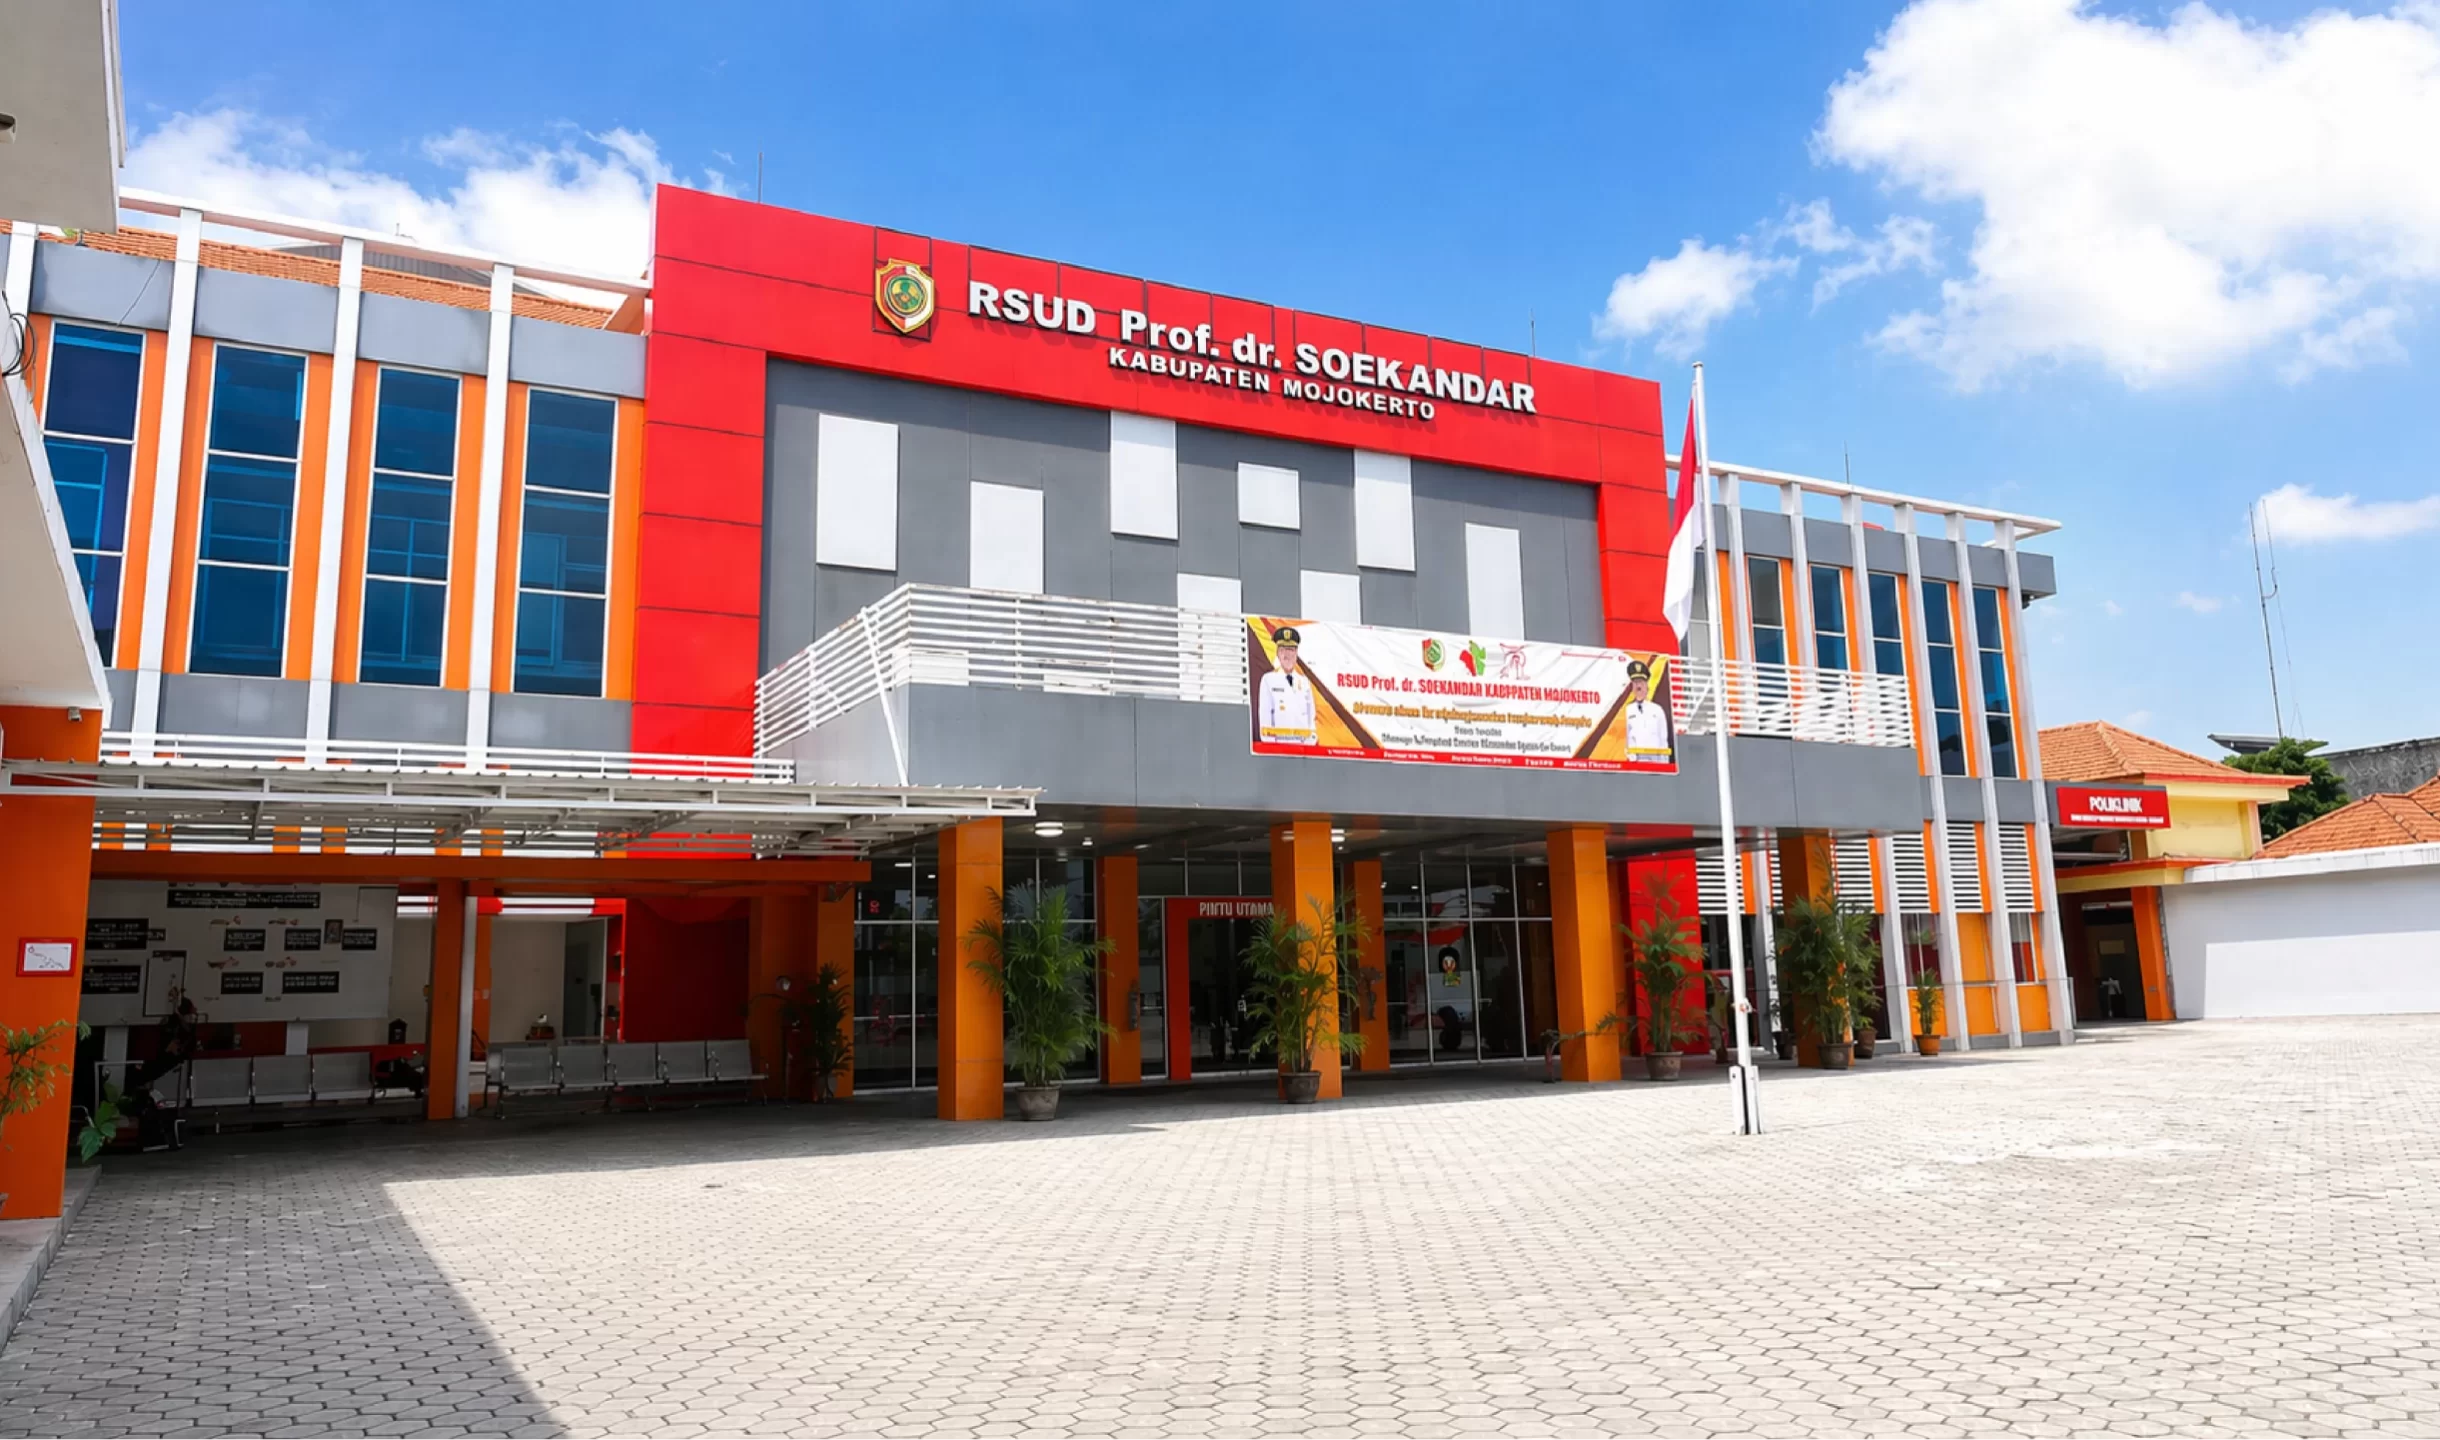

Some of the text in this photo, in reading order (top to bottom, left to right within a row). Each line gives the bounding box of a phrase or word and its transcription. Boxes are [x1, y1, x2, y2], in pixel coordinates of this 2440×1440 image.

[968, 279, 1537, 414] RSUD Prof. dr. SOEKANDAR
[1109, 346, 1436, 420] KABUPATEN MOJOKERTO
[1337, 673, 1369, 689] RSUD
[1371, 676, 1399, 692] Prof.
[1401, 678, 1417, 693] dr.
[2088, 796, 2143, 813] POLIKLINIK
[1199, 902, 1233, 916] PINTU
